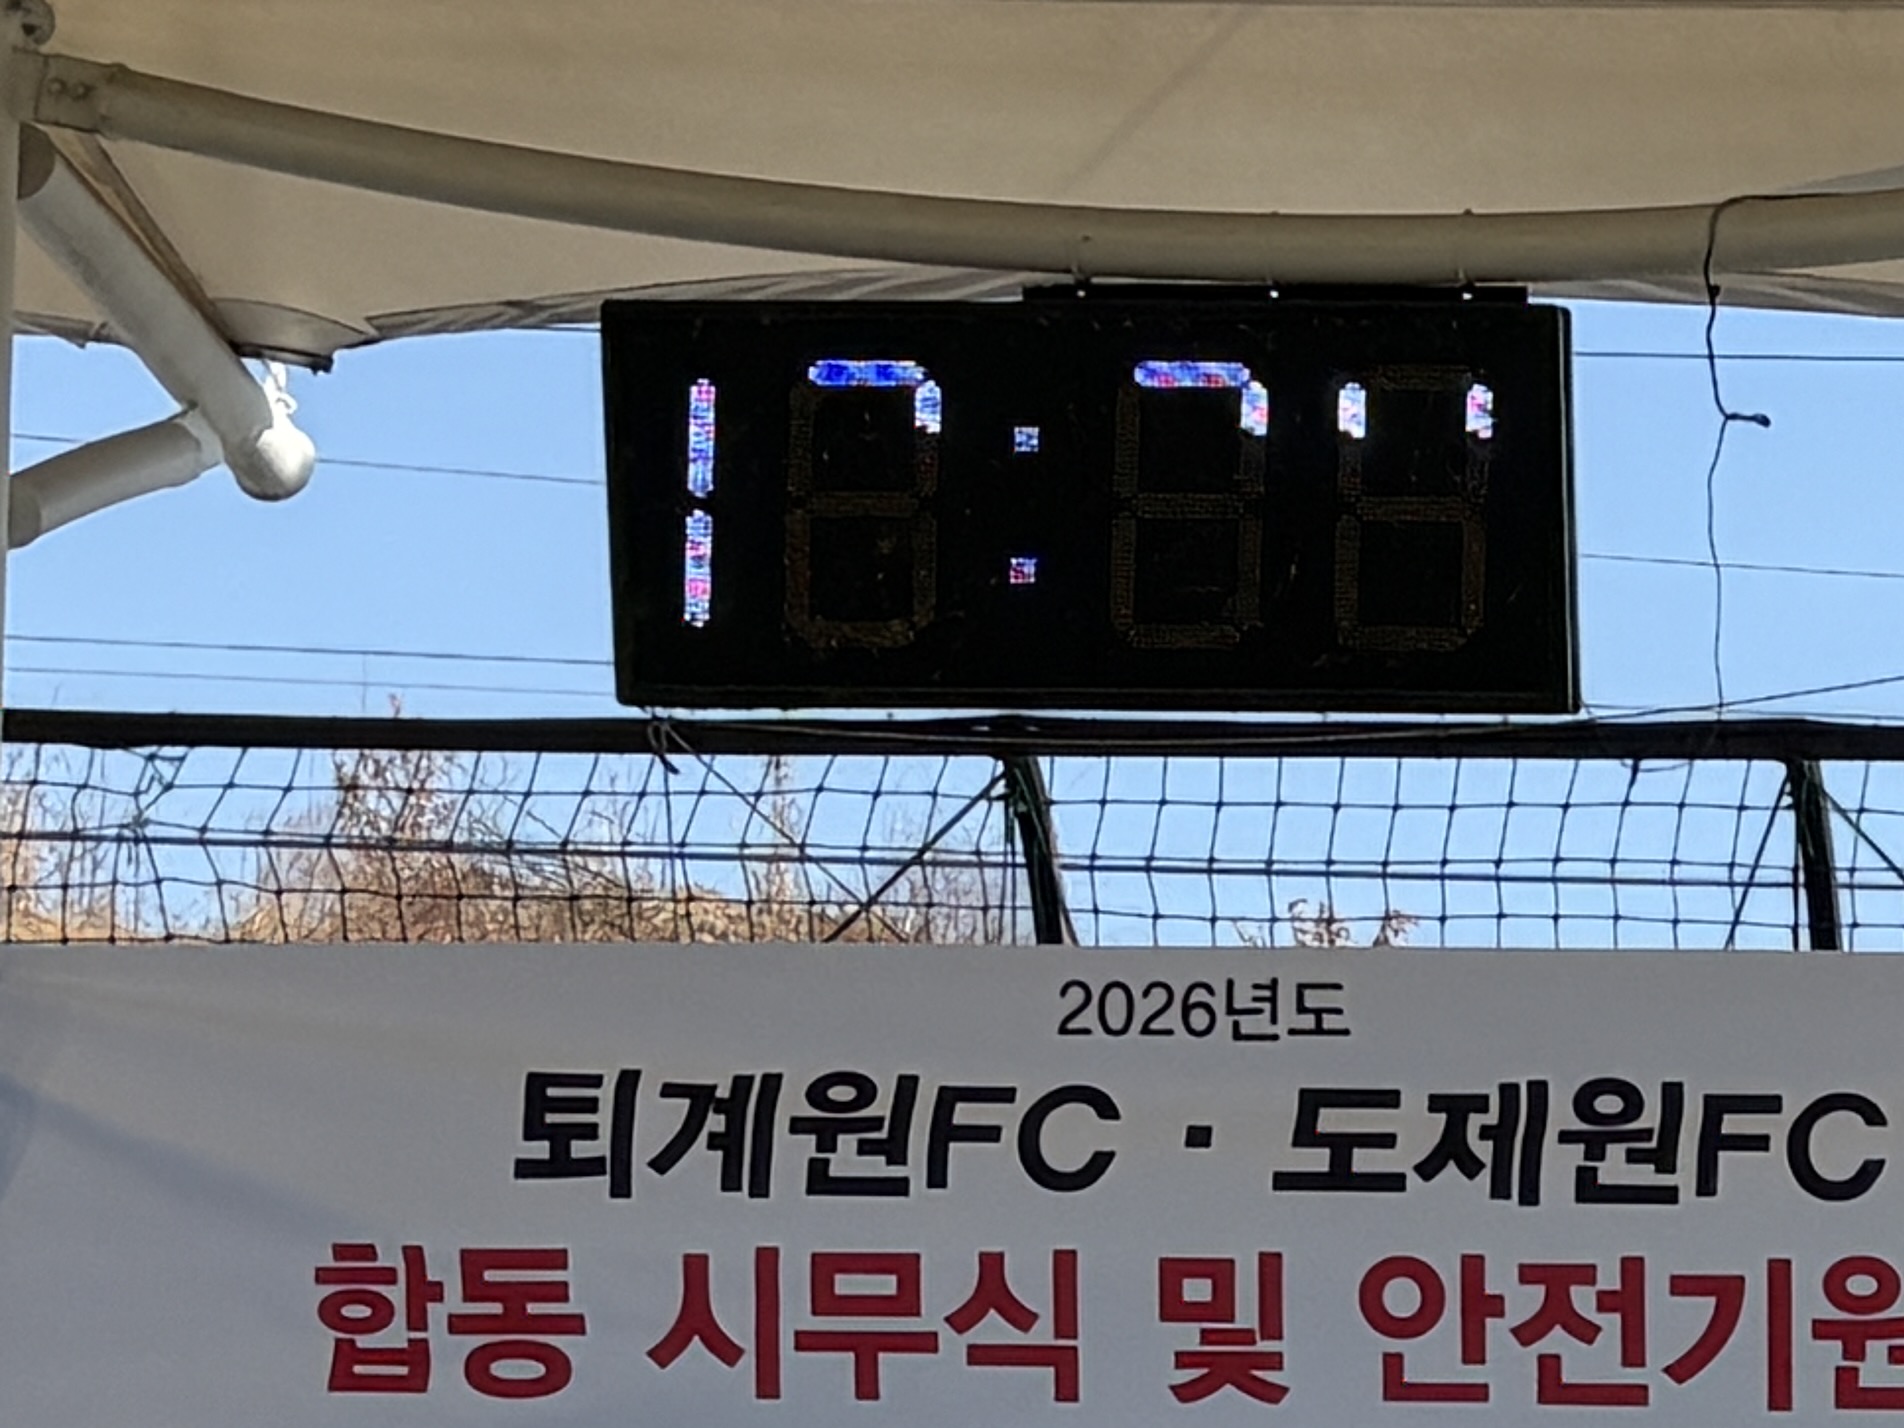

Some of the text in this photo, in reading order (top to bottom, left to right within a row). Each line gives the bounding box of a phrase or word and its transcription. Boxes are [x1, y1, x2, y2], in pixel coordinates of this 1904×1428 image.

[1056, 975, 1353, 1043] 2026년도
[512, 1067, 1123, 1201] 퇴계원FC
[1270, 1076, 1890, 1208] 도제원FC
[313, 1242, 588, 1400] 합동
[646, 1245, 1081, 1402] 시무식
[1157, 1251, 1289, 1405] 및
